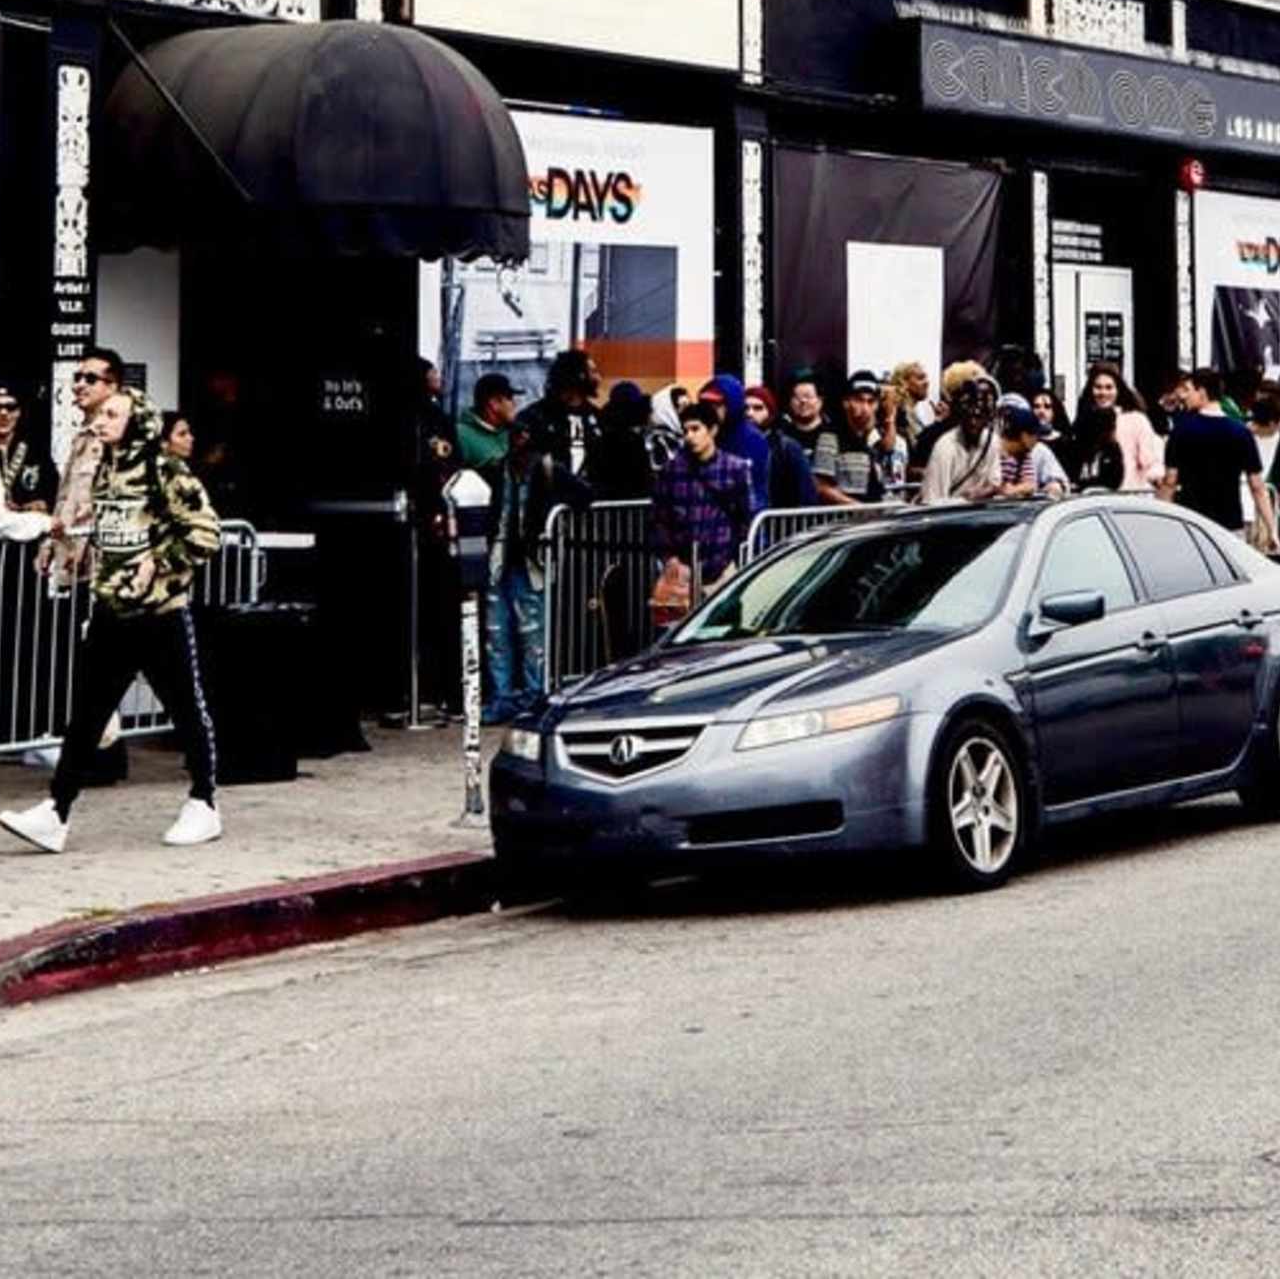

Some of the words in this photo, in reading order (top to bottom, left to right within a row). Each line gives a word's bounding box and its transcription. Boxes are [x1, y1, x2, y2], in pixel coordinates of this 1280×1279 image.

[1226, 116, 1253, 139] LOS
[50, 323, 92, 336] GUEST
[57, 343, 84, 356] LIST
